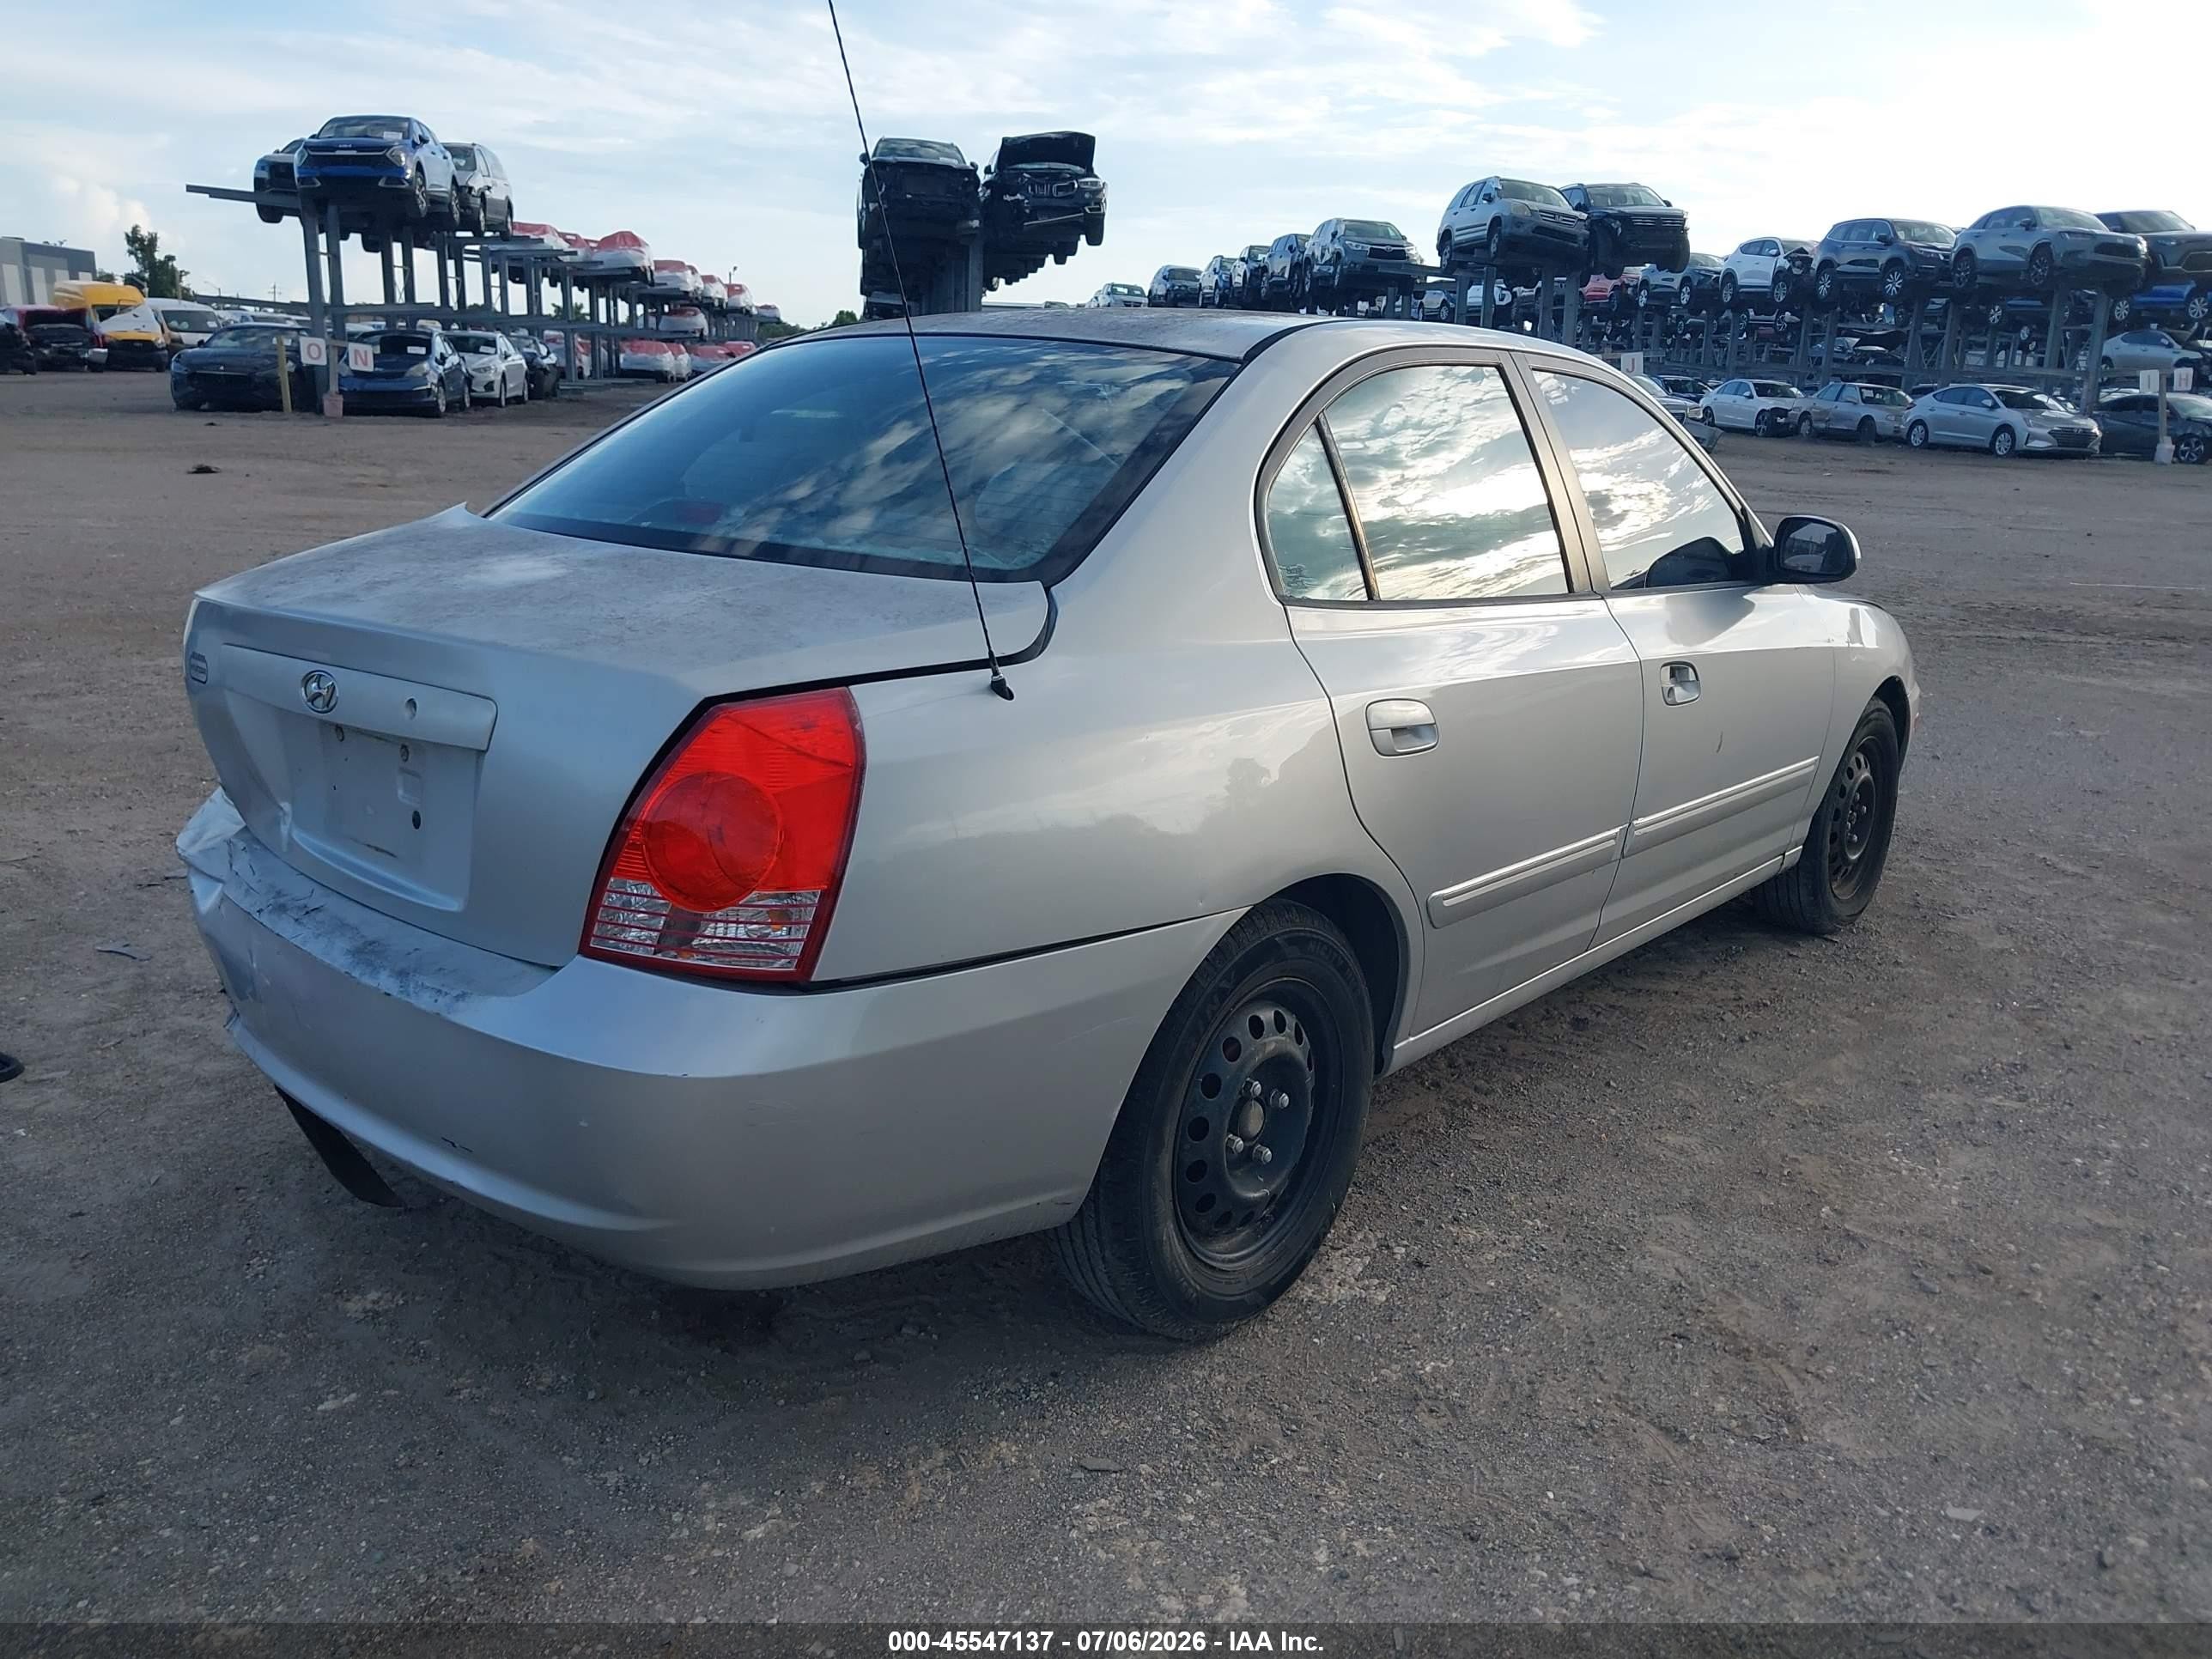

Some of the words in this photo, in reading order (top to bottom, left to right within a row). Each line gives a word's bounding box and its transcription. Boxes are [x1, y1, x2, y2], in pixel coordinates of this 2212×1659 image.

[307, 343, 322, 361] O
[353, 348, 368, 367] N
[1626, 357, 1636, 374] J
